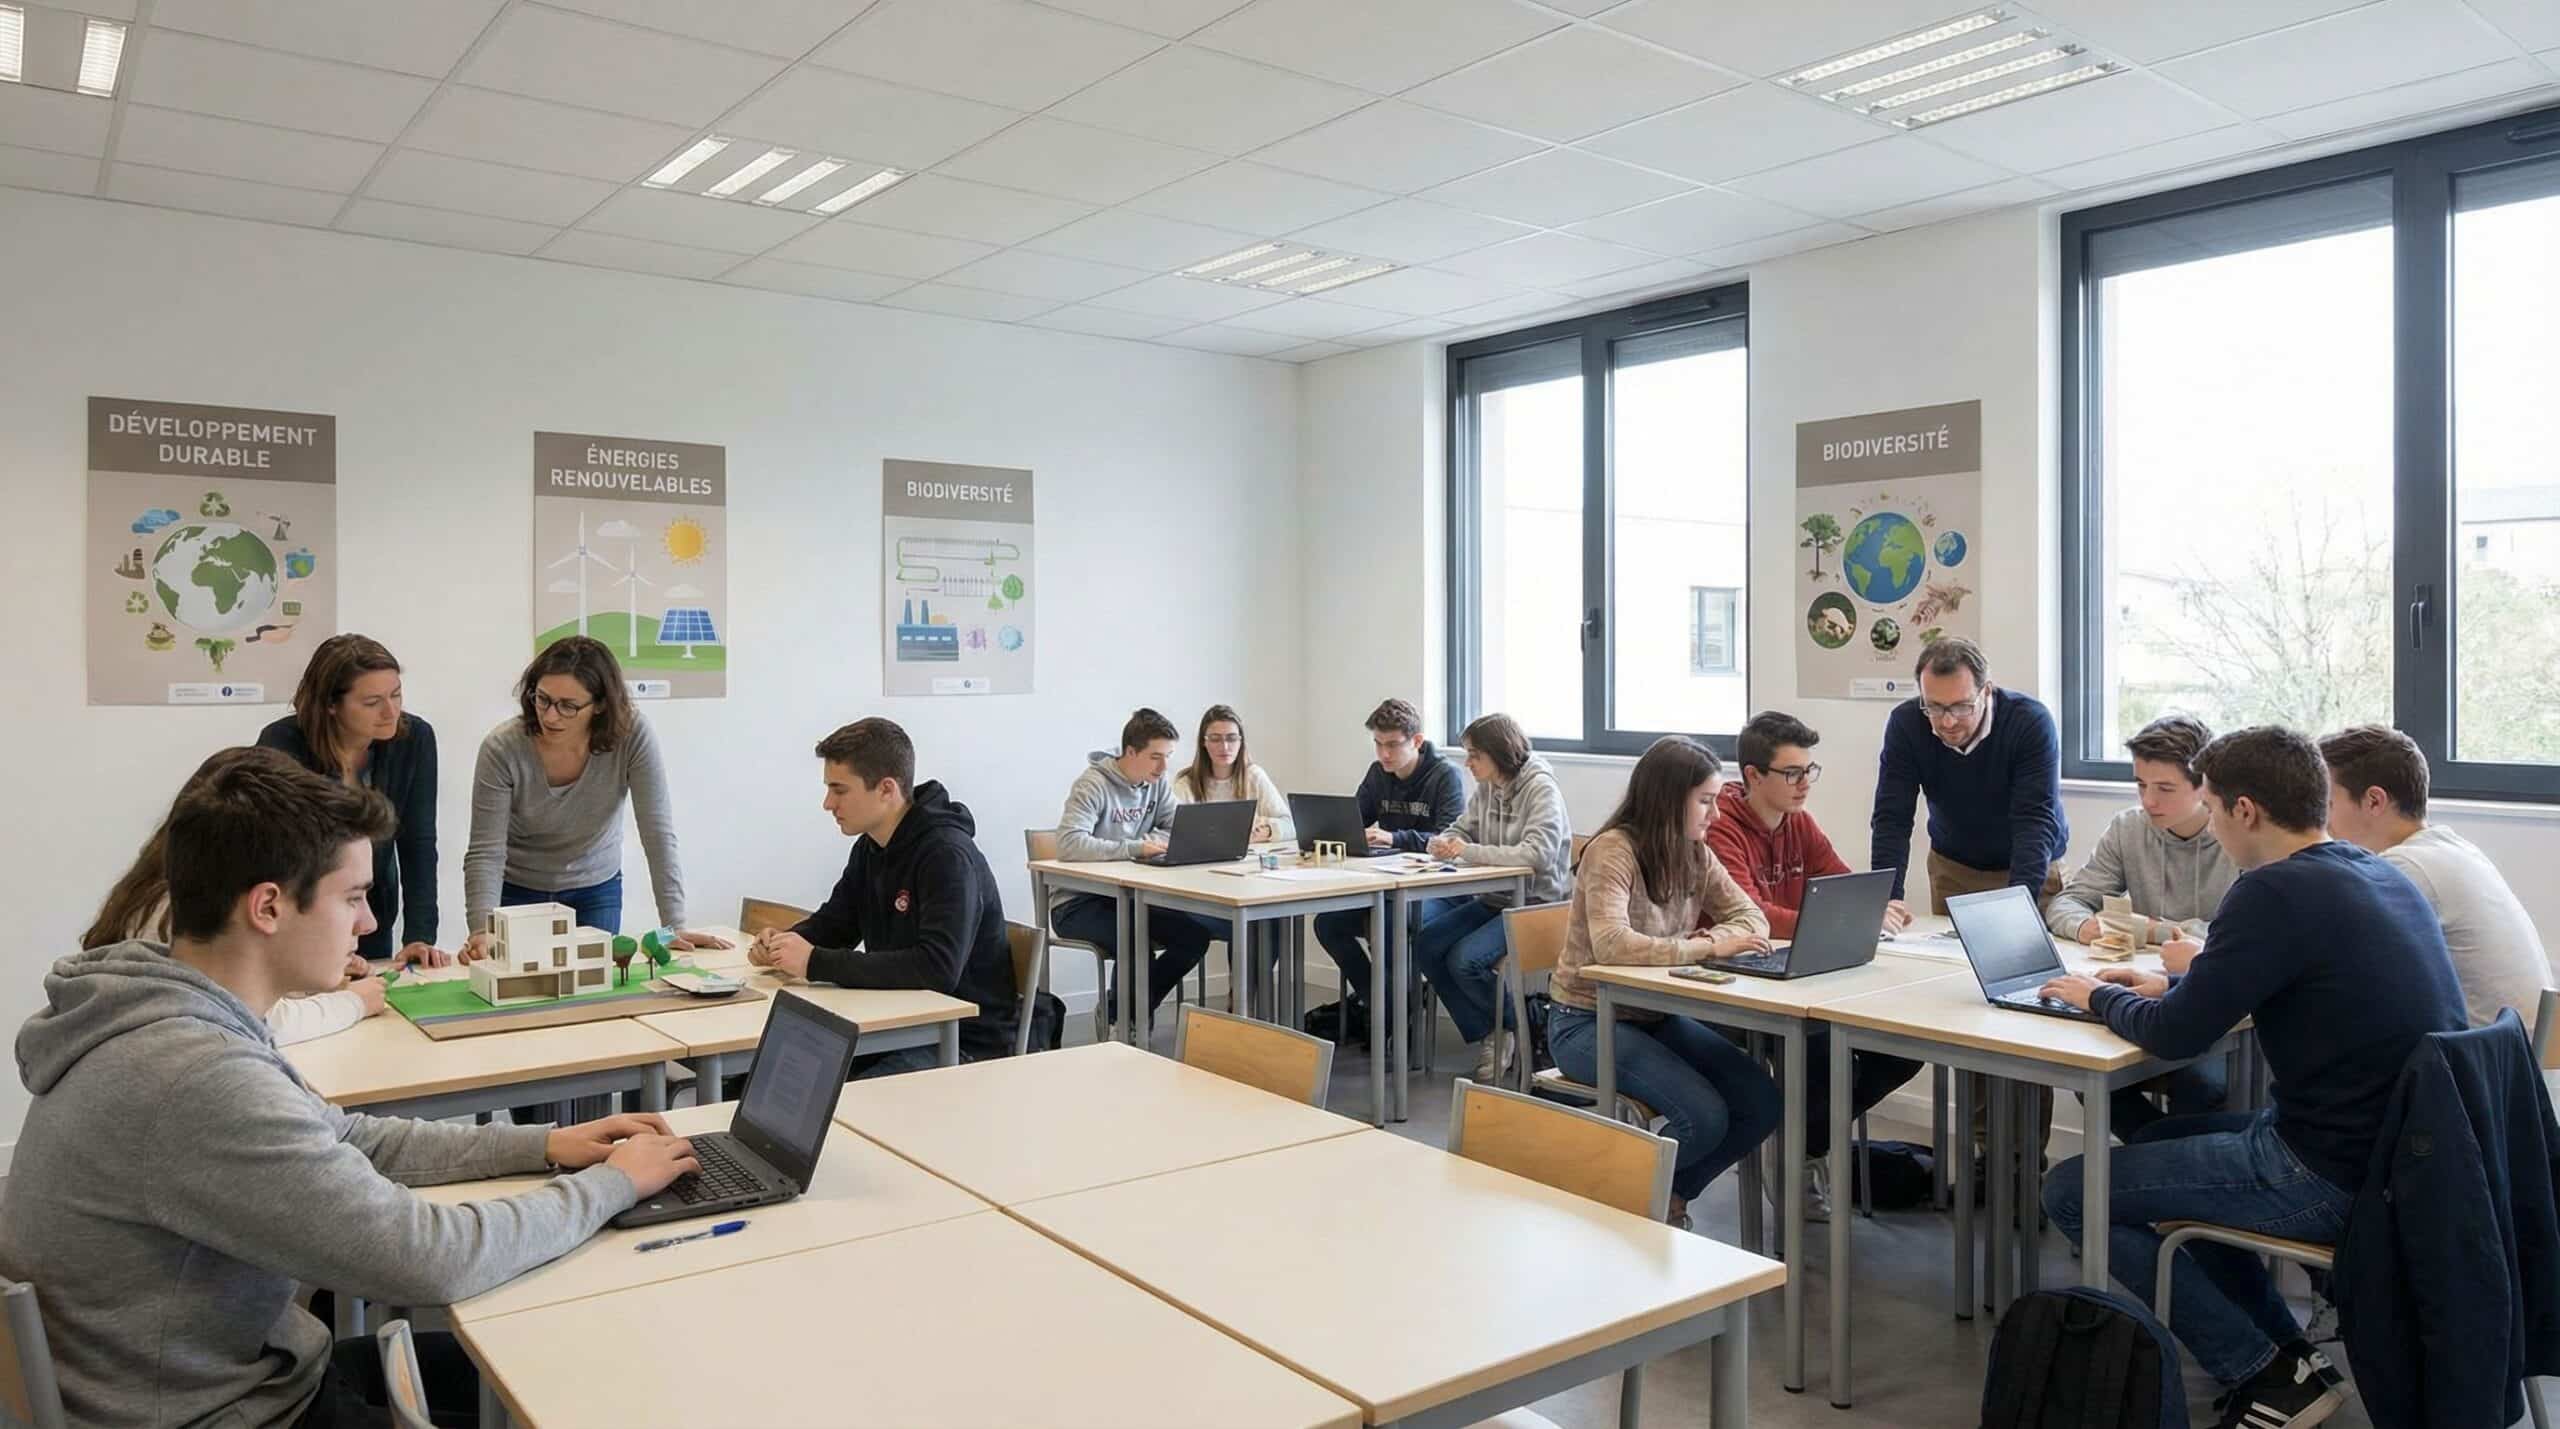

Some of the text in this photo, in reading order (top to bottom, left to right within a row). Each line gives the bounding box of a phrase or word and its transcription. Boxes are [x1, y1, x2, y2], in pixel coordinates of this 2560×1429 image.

[109, 409, 317, 446] DÉVELOPPEMENT
[158, 444, 271, 468] DURABLE
[587, 443, 679, 469] ÉNERGIES
[1822, 424, 1950, 462] BIODIVERSITÉ
[551, 468, 712, 495] RENOUVELABLES
[907, 480, 1012, 503] BIODIVERSITÉ
